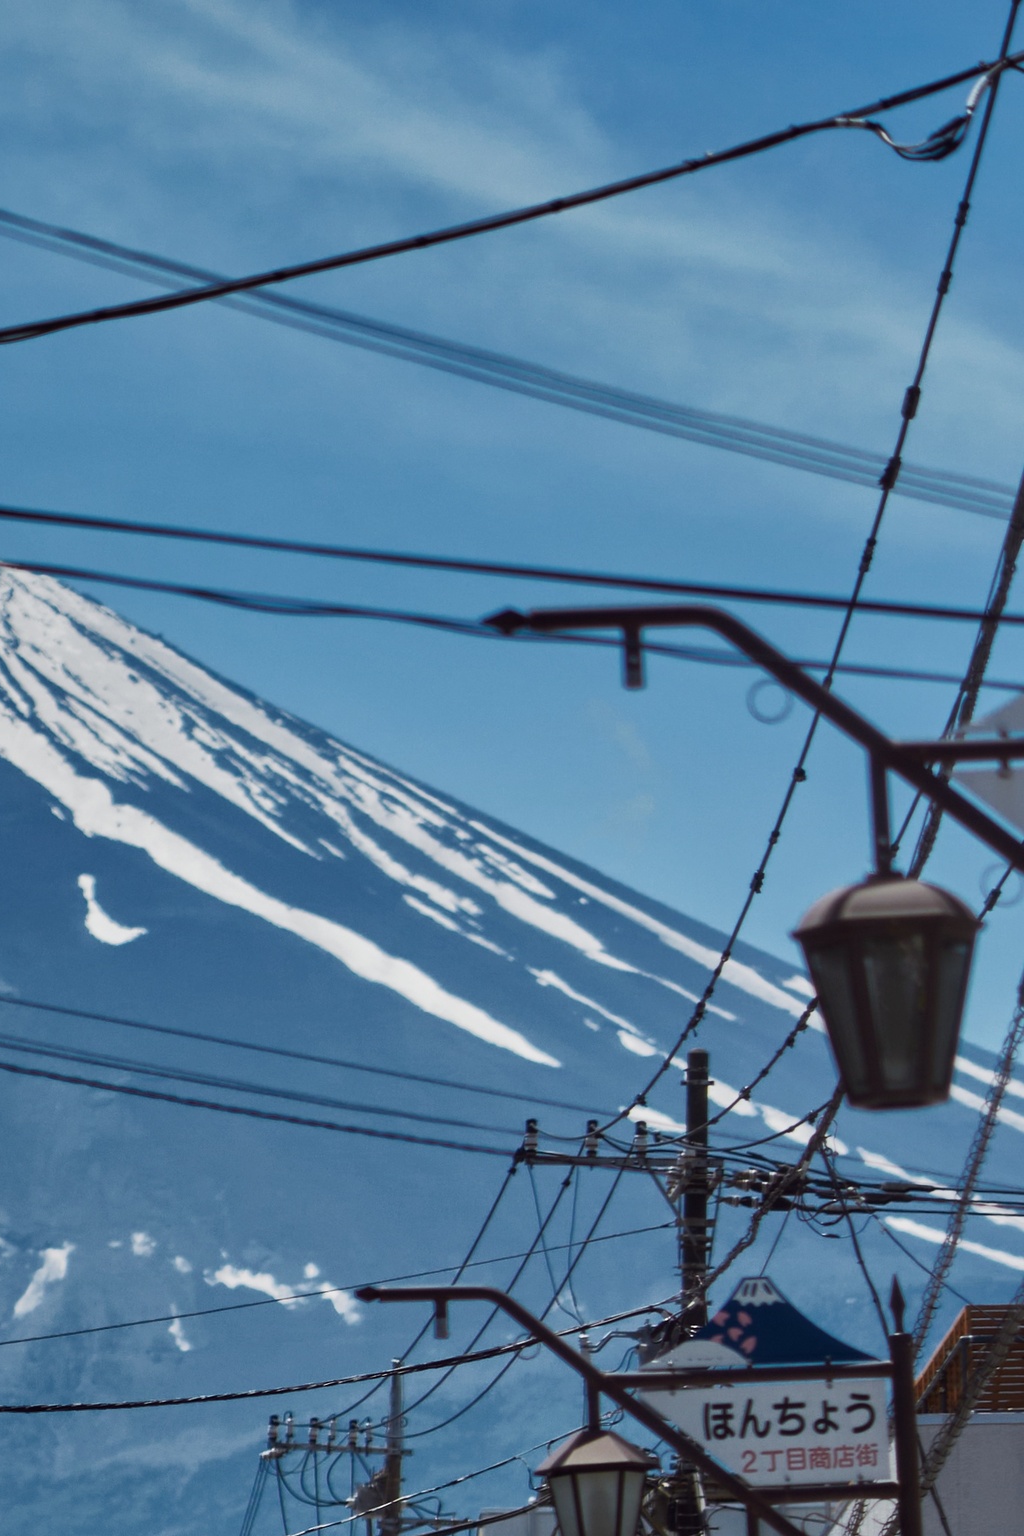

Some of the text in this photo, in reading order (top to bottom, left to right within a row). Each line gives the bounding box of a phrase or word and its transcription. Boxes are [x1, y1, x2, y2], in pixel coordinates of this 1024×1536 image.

[704, 1393, 875, 1441] ほんちょう
[742, 1443, 878, 1473] 2丁目商店街
